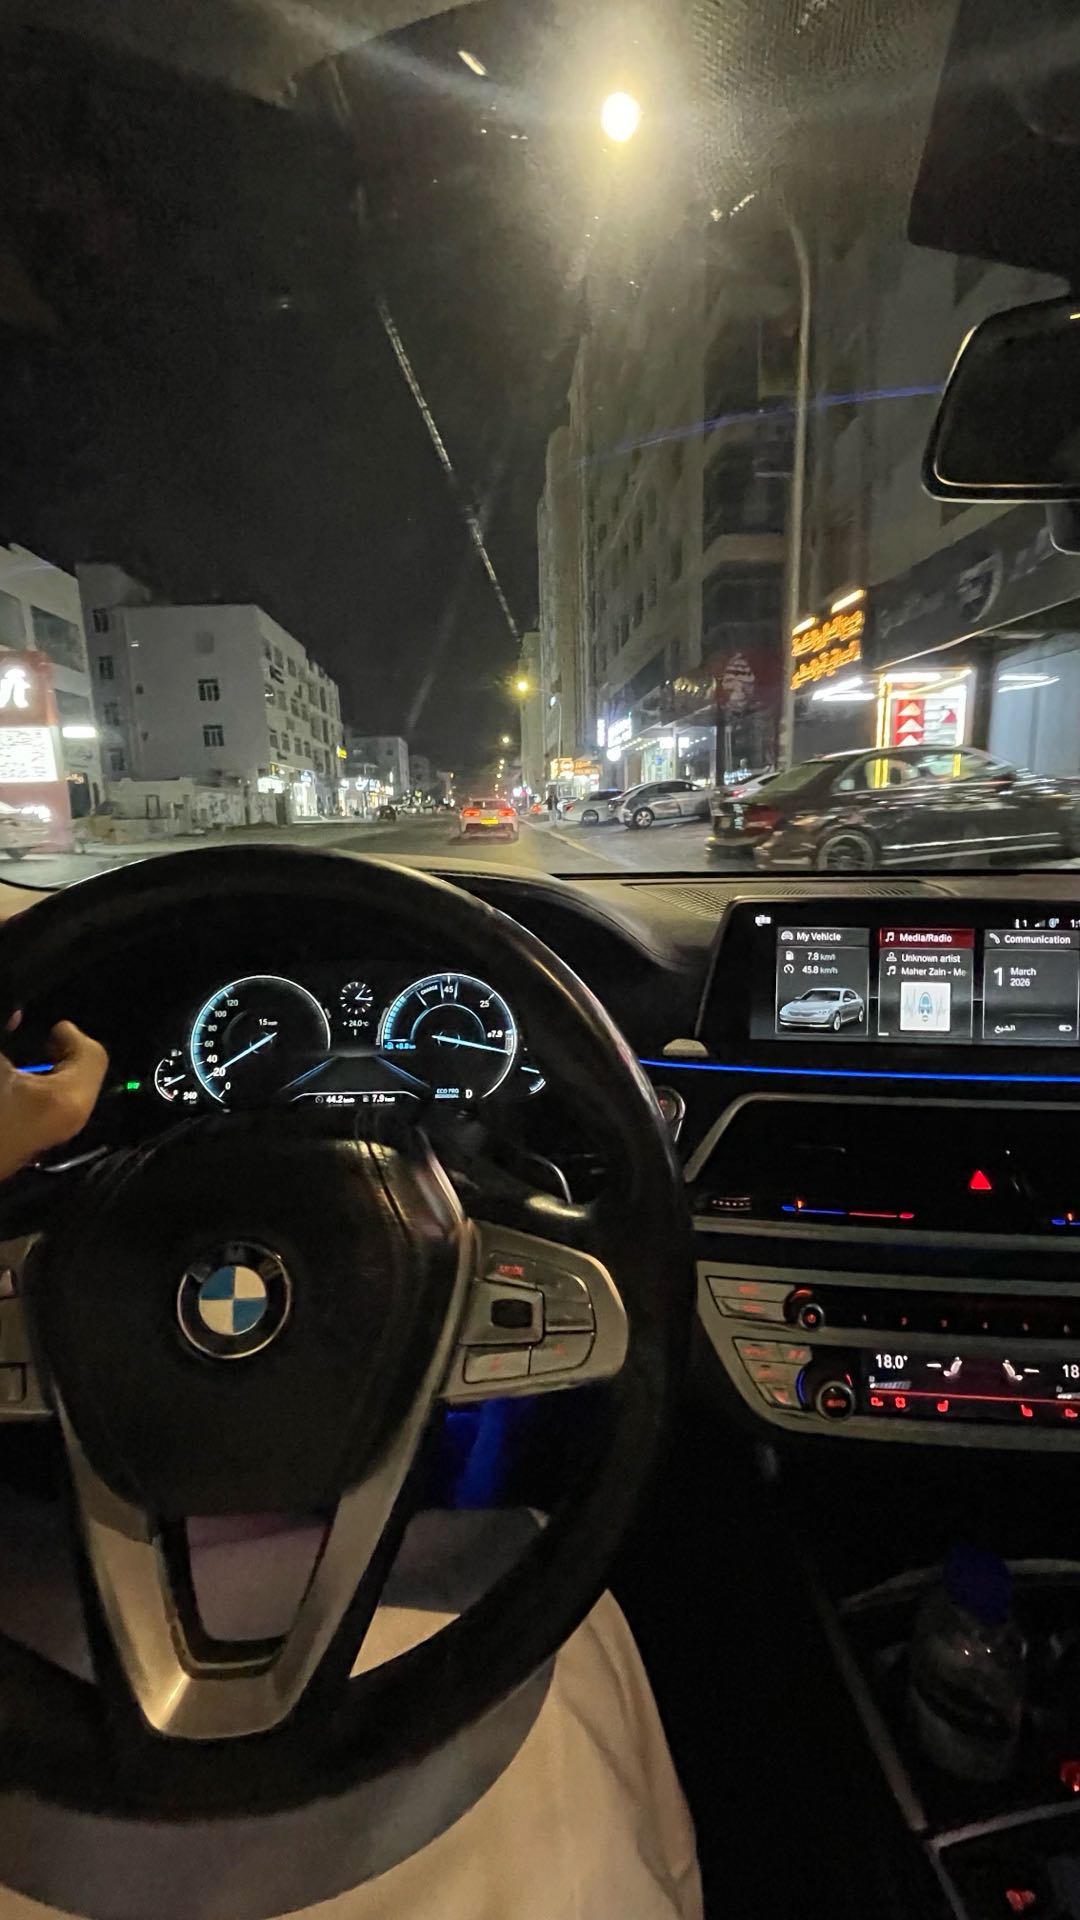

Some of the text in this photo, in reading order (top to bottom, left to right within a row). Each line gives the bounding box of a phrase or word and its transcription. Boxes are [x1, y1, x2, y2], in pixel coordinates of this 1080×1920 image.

[797, 931, 842, 942] My Vehicle
[900, 932, 952, 943] Media/Radio
[1004, 934, 1071, 945] Communication
[807, 952, 819, 961] 7.8
[902, 953, 961, 963] Unknown artist
[802, 965, 838, 974] 45.8 km/h
[902, 967, 926, 976] Maher
[929, 967, 946, 976] Zain
[1010, 967, 1037, 976] March
[993, 967, 1003, 986] 1
[1010, 978, 1031, 987] 2026
[444, 985, 454, 993] 45
[226, 999, 239, 1007] 120
[480, 1000, 490, 1008] 25
[214, 1010, 227, 1018] 100
[206, 1055, 218, 1063] 40
[213, 1067, 226, 1077] 20
[225, 1081, 231, 1090] 0
[372, 1093, 385, 1103] 7.9
[465, 1089, 473, 1099] D
[326, 1094, 344, 1104] 44.2
[875, 1354, 908, 1370] 18.0°
